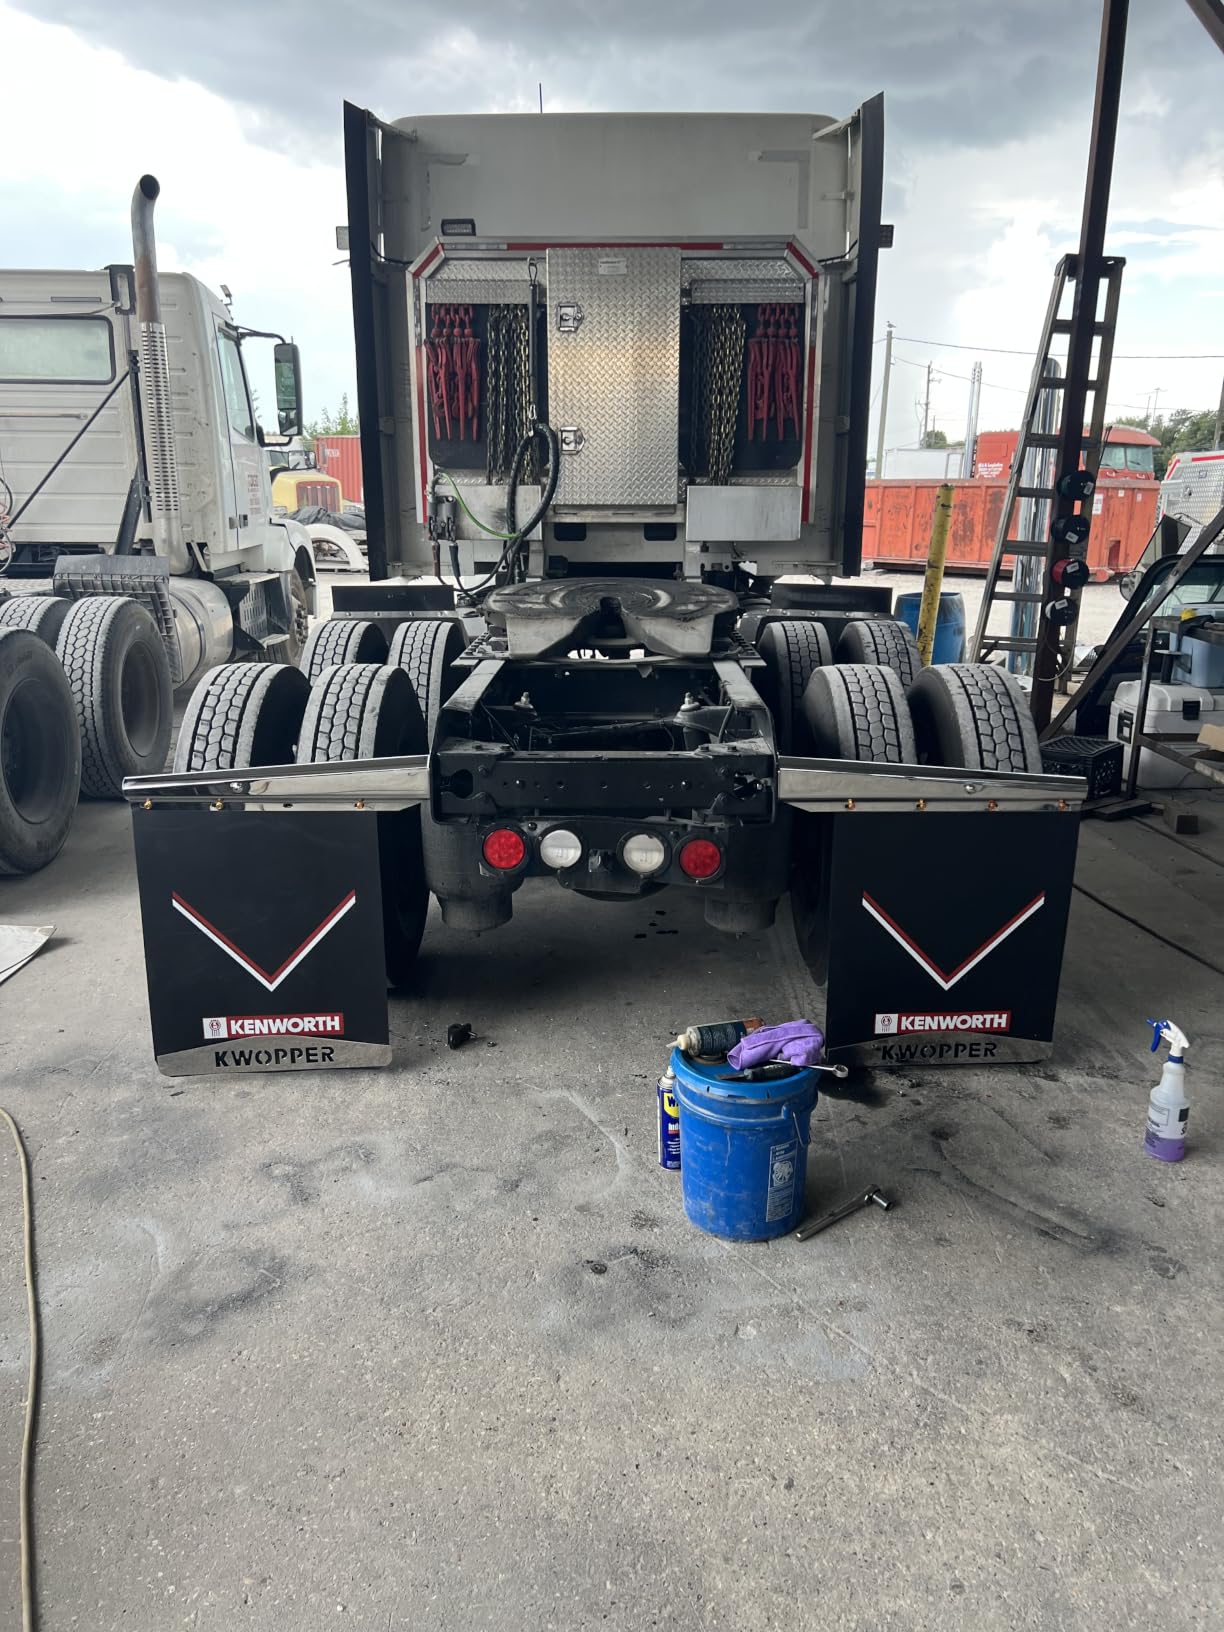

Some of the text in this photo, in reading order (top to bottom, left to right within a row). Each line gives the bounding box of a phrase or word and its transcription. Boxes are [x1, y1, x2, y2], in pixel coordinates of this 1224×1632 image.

[230, 1016, 340, 1035] KENWORTH
[901, 1014, 1007, 1030] KENWORTH
[215, 1046, 335, 1068] KWOPPER
[882, 1043, 997, 1060] KWOPPER
